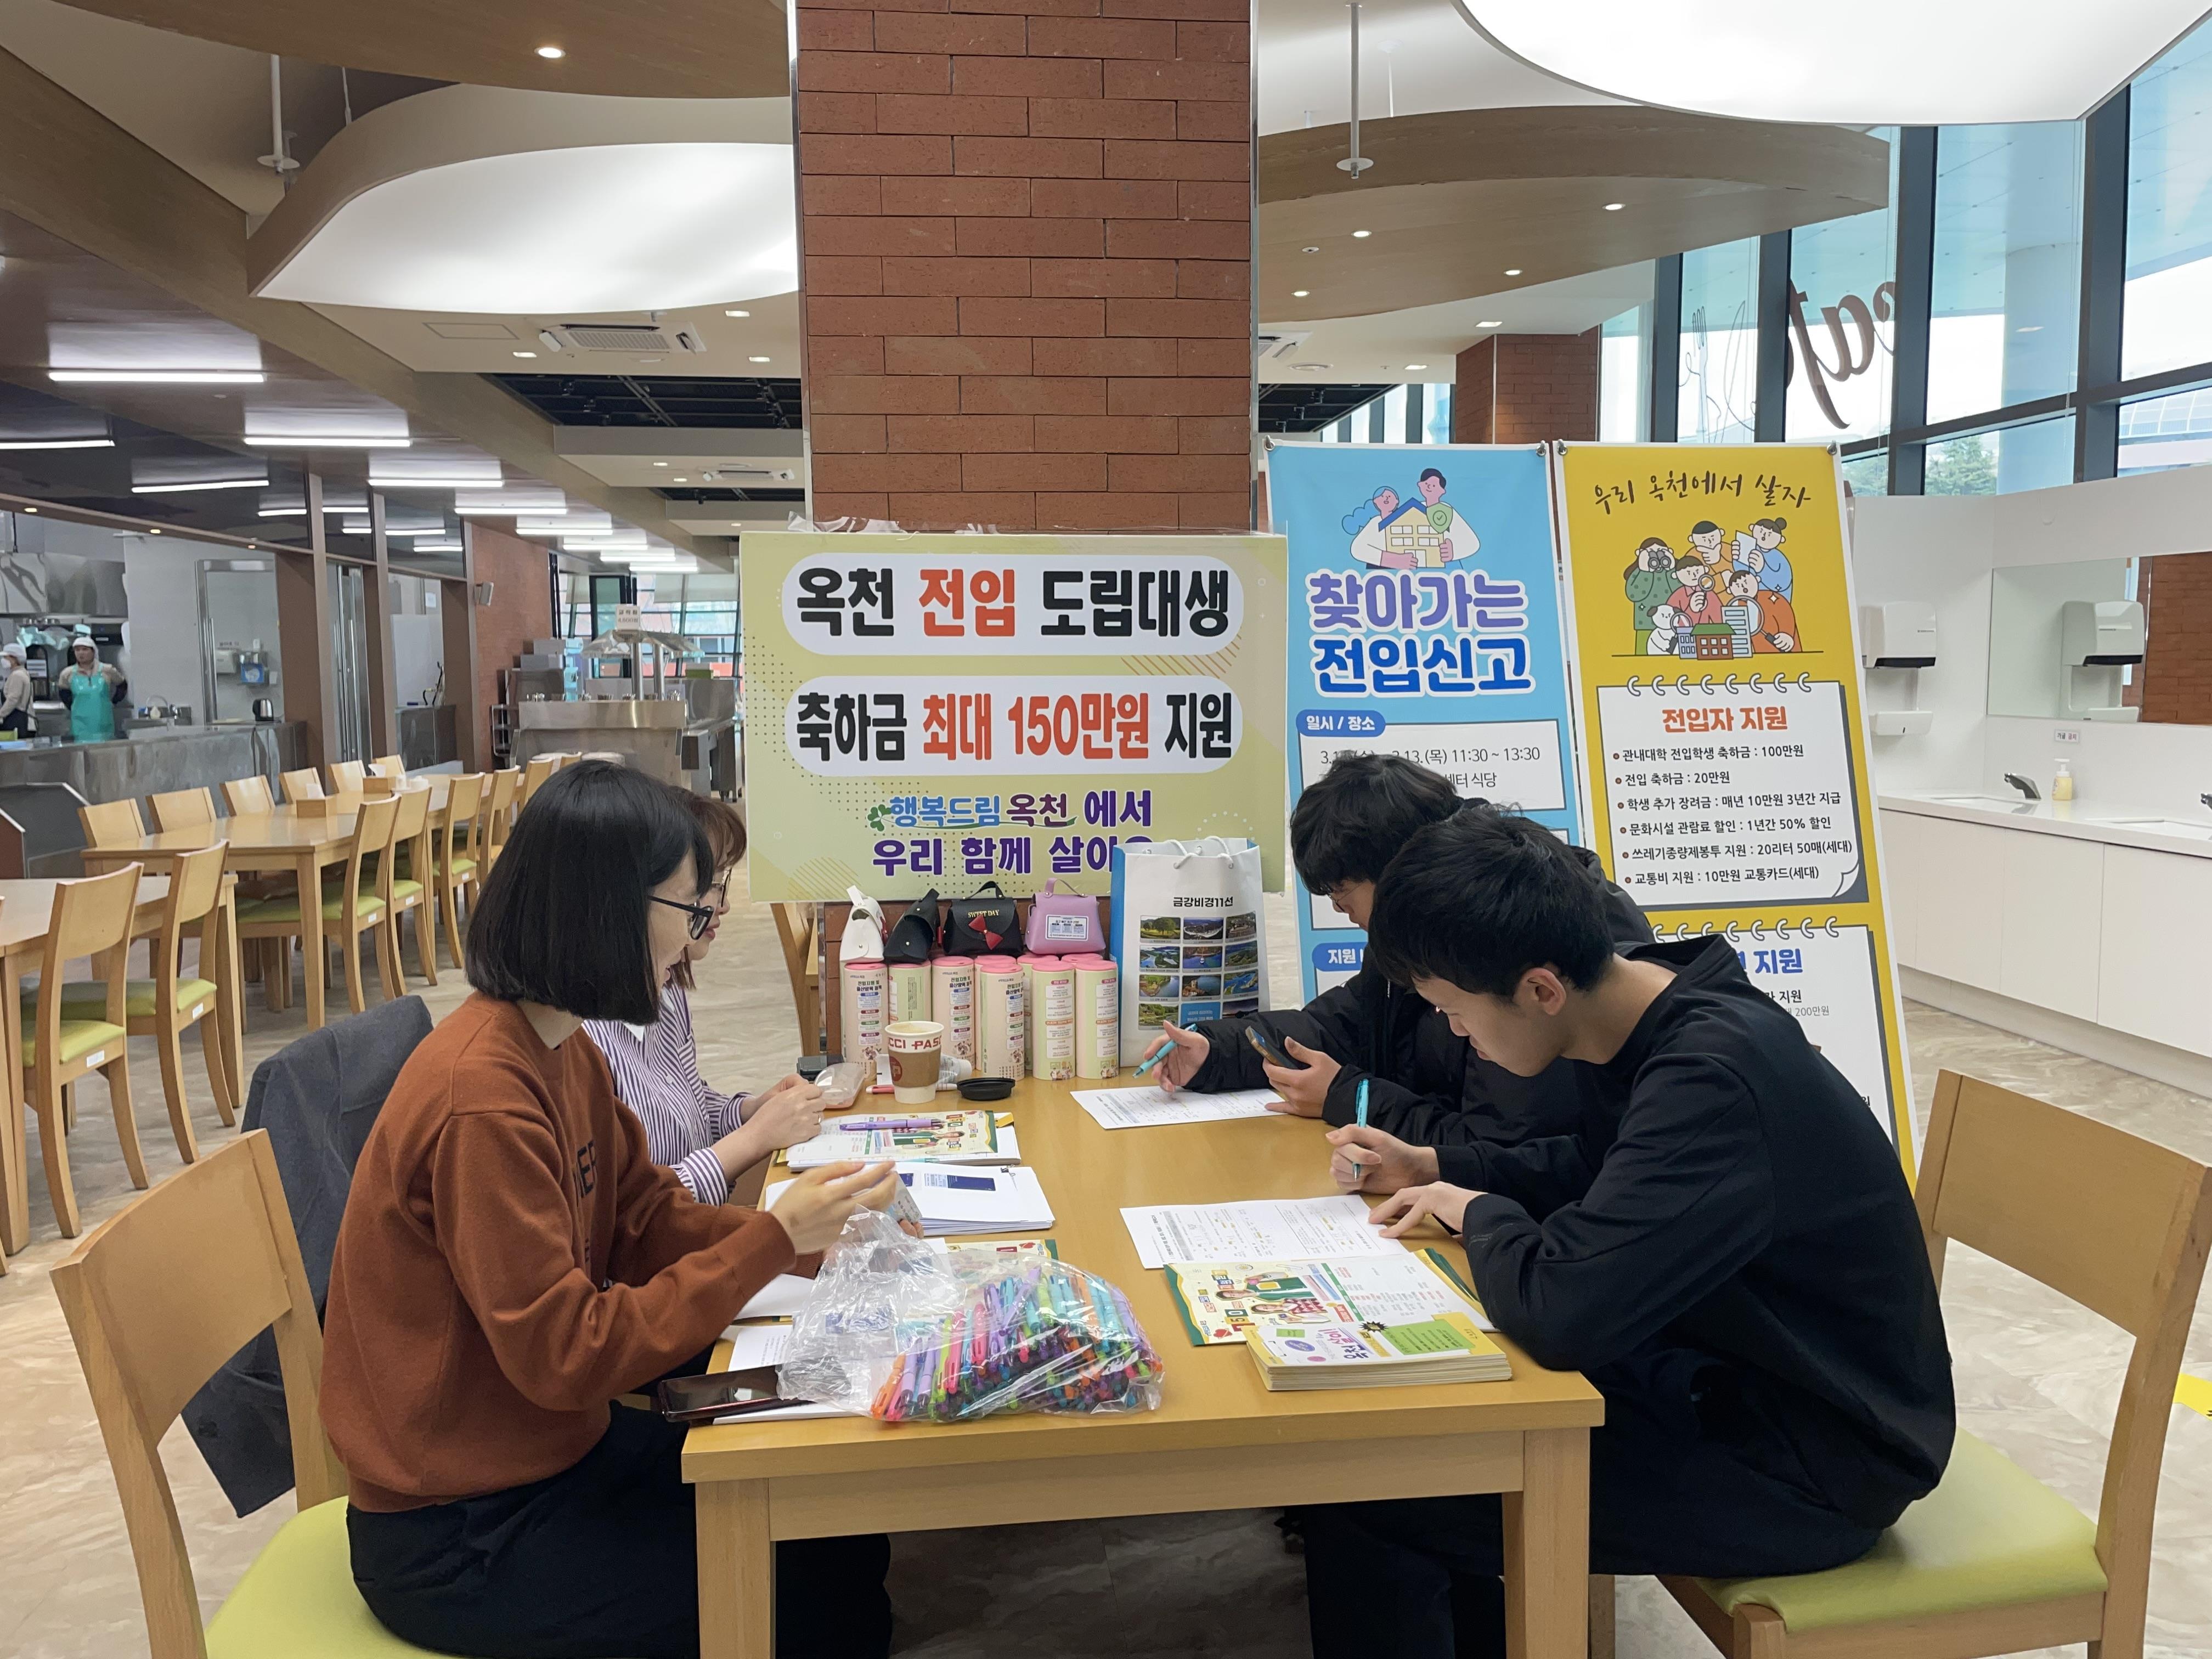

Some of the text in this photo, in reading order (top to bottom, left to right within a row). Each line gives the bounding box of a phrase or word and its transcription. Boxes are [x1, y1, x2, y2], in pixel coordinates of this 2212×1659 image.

[1595, 471, 1811, 515] 우리 옥천에서 살자
[797, 568, 1229, 637] 옥천 전입 도립대생
[1310, 573, 1524, 629] 찾아가는
[1313, 637, 1531, 693] 전입신고
[797, 692, 1232, 761] 축하금 최대 150만원 지원
[1307, 716, 1333, 731] 일시
[1348, 716, 1375, 731] 장소
[1662, 706, 1787, 733] 전입자 지원
[1452, 749, 1488, 763] 11:30
[1504, 747, 1540, 761] 13:30
[1622, 748, 1667, 761] 관내대학
[1671, 747, 1714, 761] 전입학생
[1717, 746, 1751, 760] 축하금
[1761, 744, 1804, 758] 100만원
[1471, 772, 1497, 788] 식당
[1625, 773, 1646, 786] 전입
[1650, 772, 1684, 785] 축하금
[1694, 771, 1730, 785] 20만원
[890, 790, 1152, 828] 행복드림 옥천 에서
[1627, 798, 1650, 811] 학생
[1653, 797, 1675, 810] 추가
[1678, 796, 1712, 809] 장려금
[1722, 795, 1743, 808] 매년
[1748, 794, 1784, 806] 10만원
[1787, 793, 1815, 805] 3년간
[1819, 792, 1841, 805] 지급
[1629, 822, 1674, 836] 문화시설
[1677, 821, 1711, 834] 관람료
[1714, 820, 1736, 833] 할인
[1747, 819, 1776, 831] 1년간
[1780, 818, 1805, 830] 50%
[1809, 816, 1831, 830] 할인
[872, 836, 1153, 876] 우리 함께 살아
[1632, 845, 1721, 860] 쓰레기종량제봉투
[1725, 844, 1746, 857] 지원
[1757, 842, 1793, 855] 20리터
[1797, 839, 1852, 855] 50매(세대)
[1635, 872, 1668, 885] 교통비
[1672, 871, 1694, 884] 지원
[1705, 870, 1740, 883] 10만원
[1745, 866, 1819, 881] 교통카드(세대)
[1173, 896, 1233, 907] 금강비경11선
[1328, 949, 1356, 964] 지원
[1753, 949, 1803, 974] 지원
[1779, 990, 1802, 1003] 지원
[1795, 1005, 1830, 1017] 200만원
